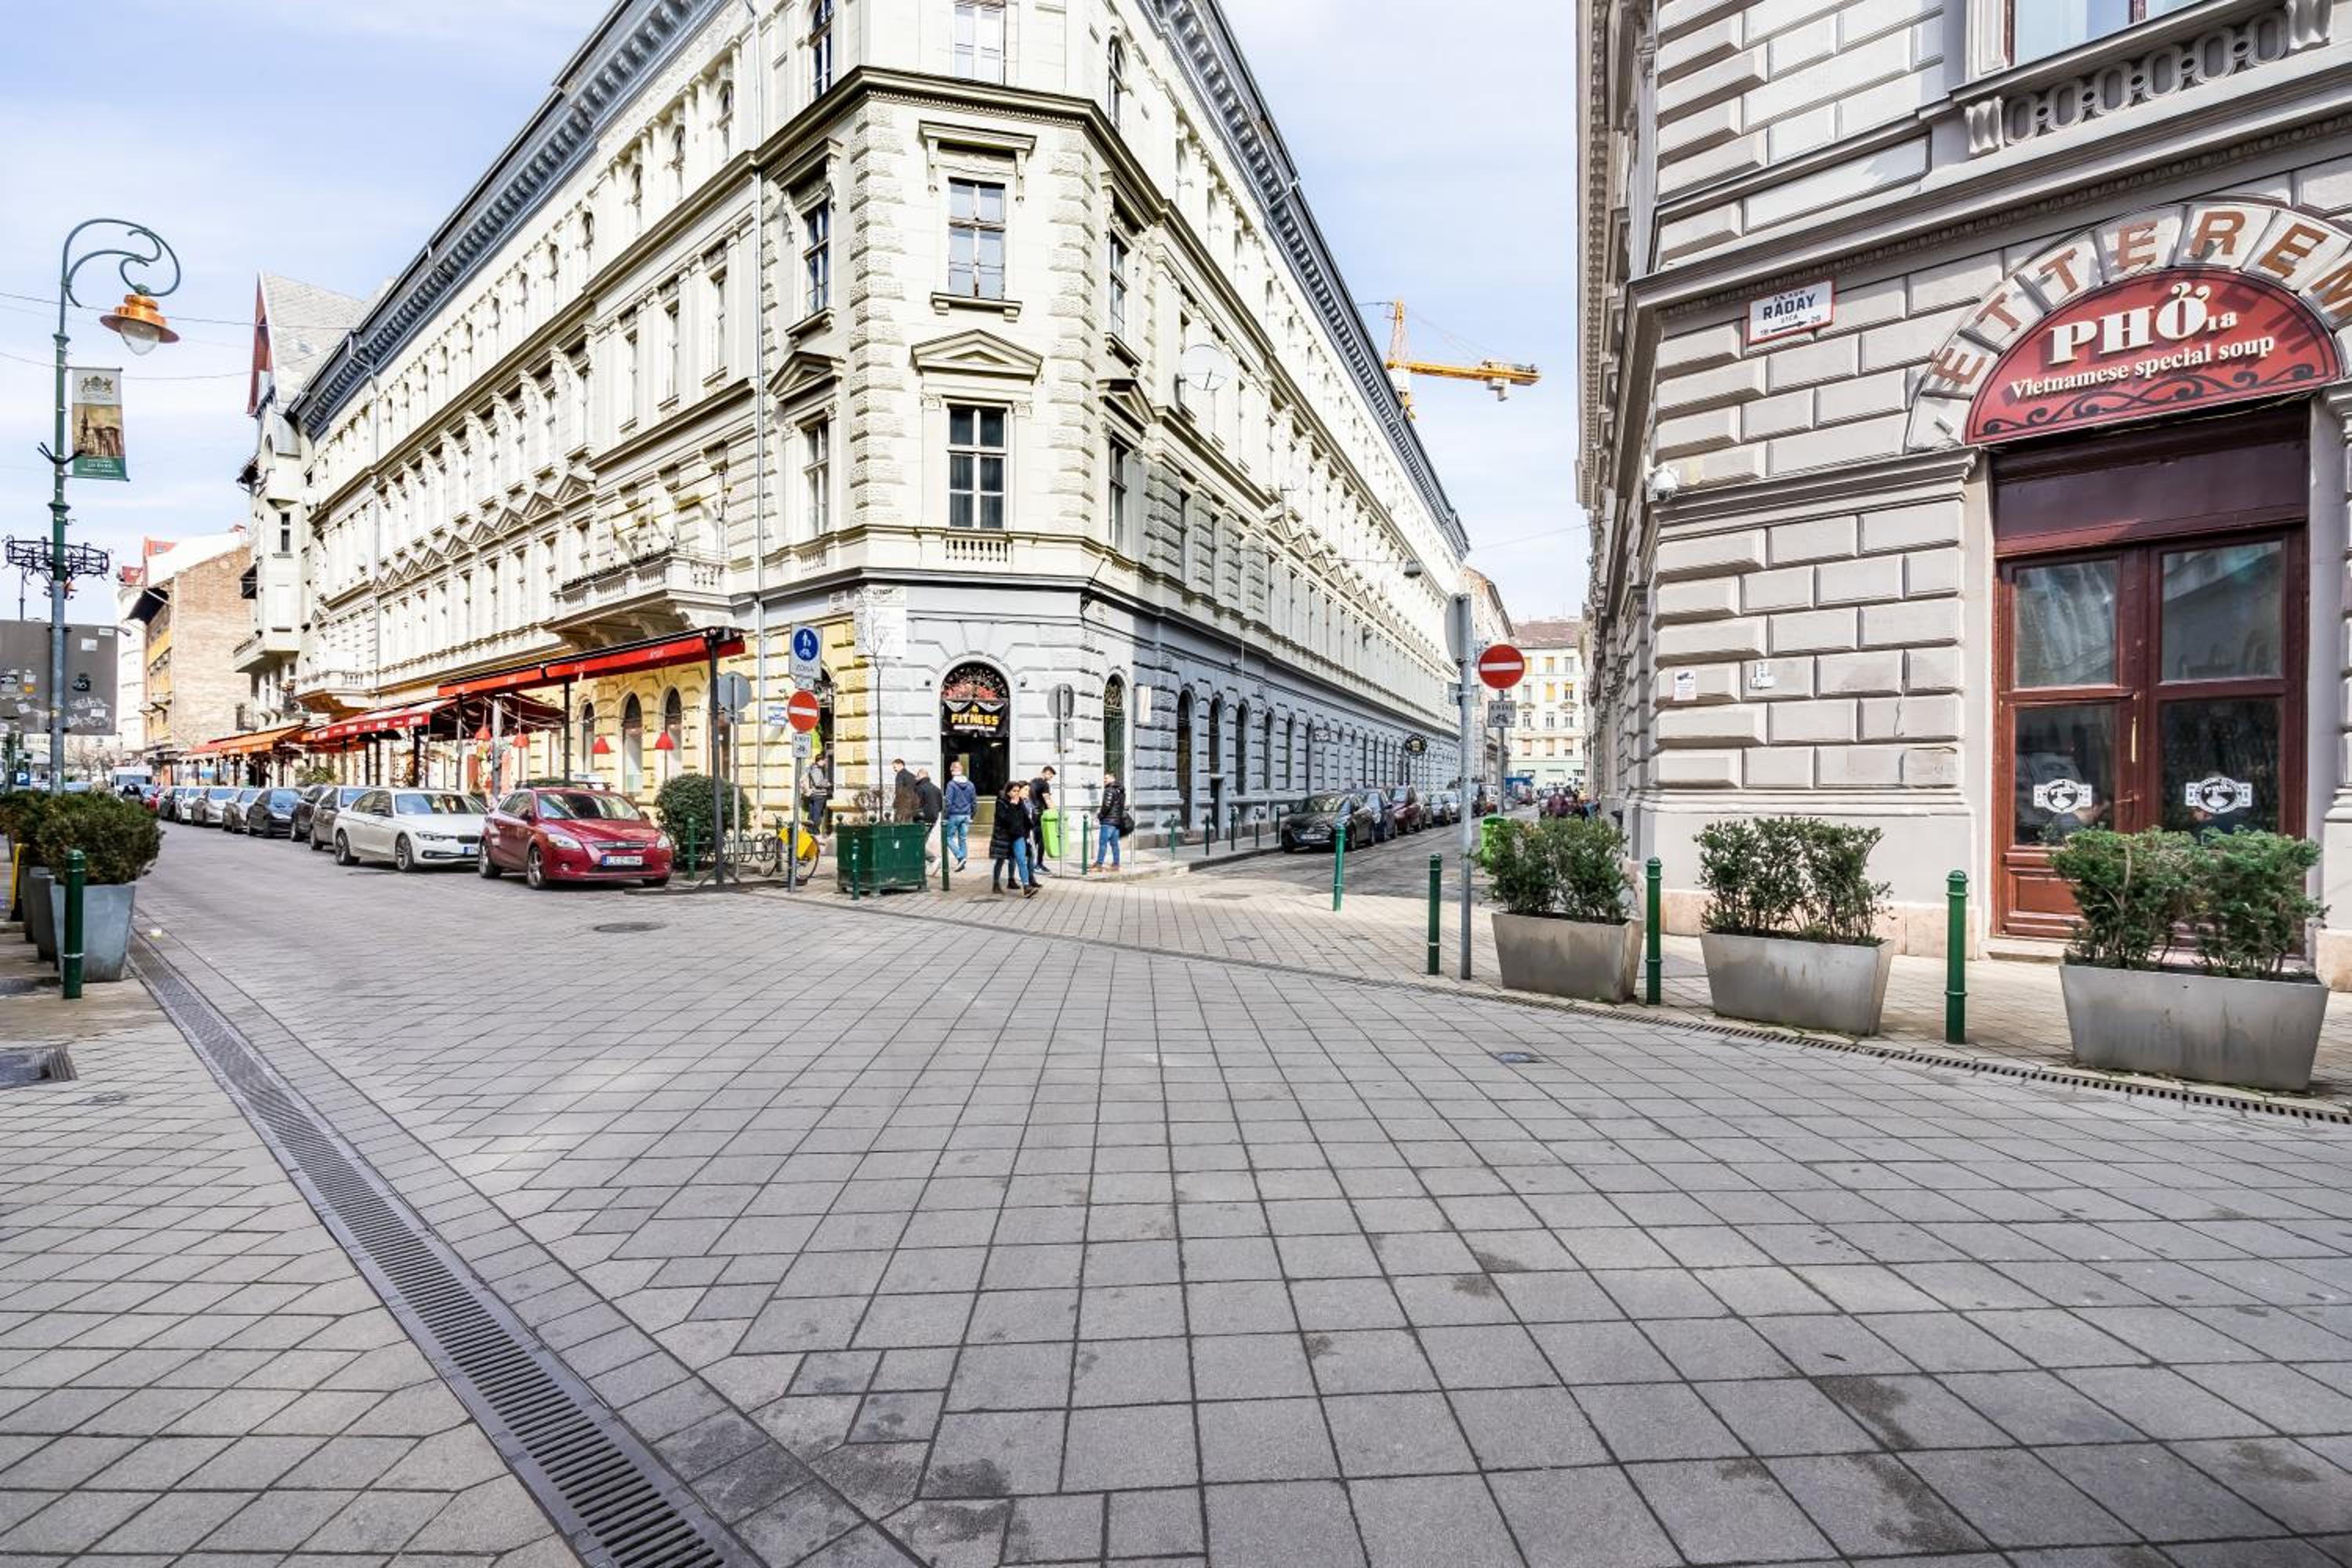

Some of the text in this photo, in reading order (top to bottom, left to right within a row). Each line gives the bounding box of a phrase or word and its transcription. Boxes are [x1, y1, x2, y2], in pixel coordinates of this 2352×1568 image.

[2010, 336, 2275, 399] Vietnamese special soup
[950, 713, 1000, 726] FITNESS
[16, 772, 28, 784] P
